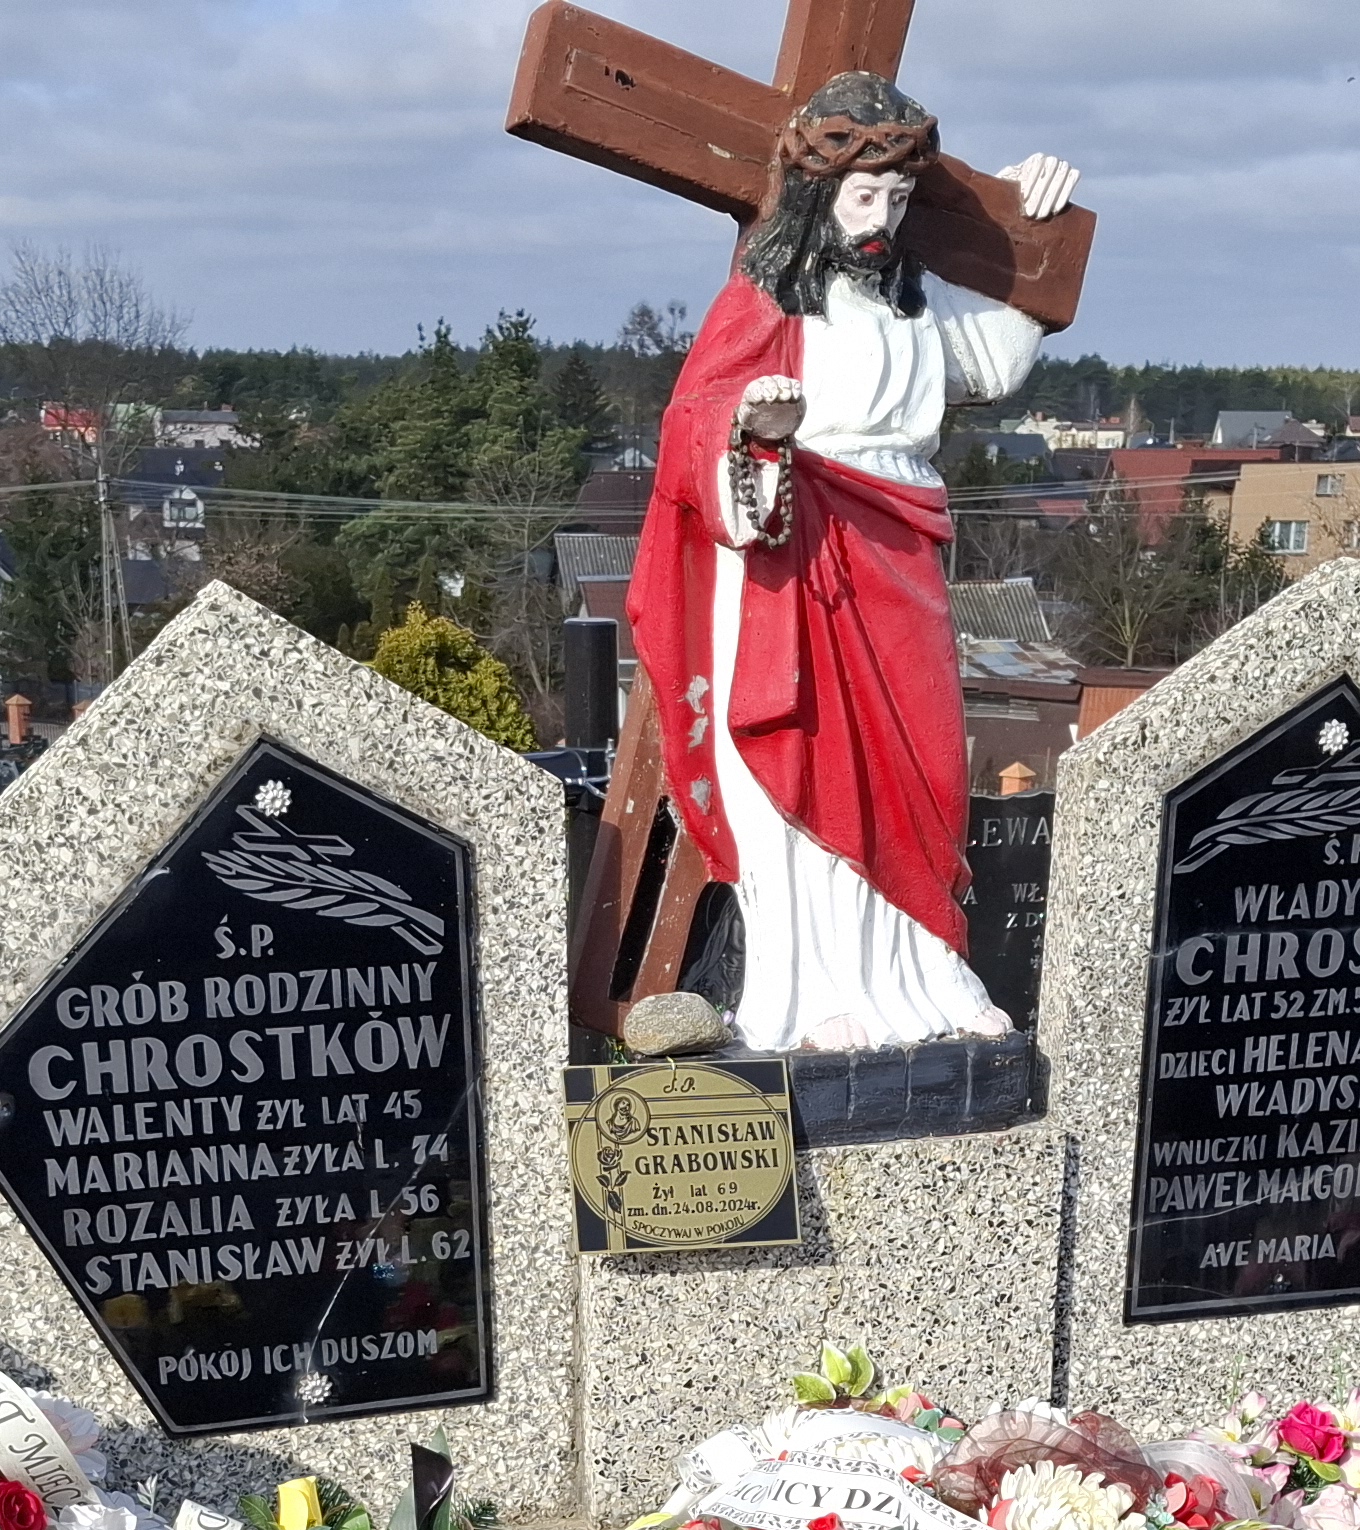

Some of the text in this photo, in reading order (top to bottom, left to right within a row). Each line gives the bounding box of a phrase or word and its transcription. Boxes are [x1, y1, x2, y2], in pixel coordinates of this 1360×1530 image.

[967, 816, 1053, 848] EWA
[214, 914, 274, 959] Ś.P.
[56, 962, 438, 1030] GRÓB RODZINNY
[1220, 991, 1268, 1023] LAT
[1270, 990, 1305, 1020] 52
[28, 1011, 451, 1101] CHROSTKÓW
[1159, 1048, 1236, 1080] DZIECI
[43, 1095, 243, 1147] WALENTY
[322, 1094, 370, 1126] LAT
[383, 1089, 423, 1120] 45
[646, 1120, 776, 1147] STANISŁAW
[44, 1143, 280, 1198] MARIANNA
[375, 1138, 400, 1170] L.
[412, 1134, 450, 1165] 74
[634, 1148, 780, 1176] GRABOWSKI
[1153, 1133, 1267, 1167] WNUCZKI
[652, 1181, 738, 1202] Żył lat 69
[1148, 1170, 1254, 1214] PAWEŁ
[64, 1194, 255, 1247] ROZALIA
[399, 1184, 440, 1215] 56
[627, 1206, 649, 1217] zm.
[693, 1226, 706, 1239] W
[85, 1237, 327, 1295] STANISŁAW
[401, 1234, 427, 1265] L.
[431, 1229, 471, 1261] 62
[1199, 1233, 1337, 1269] AVE MARIA
[264, 1341, 312, 1375] ICH
[322, 1328, 439, 1368] DUSZOM
